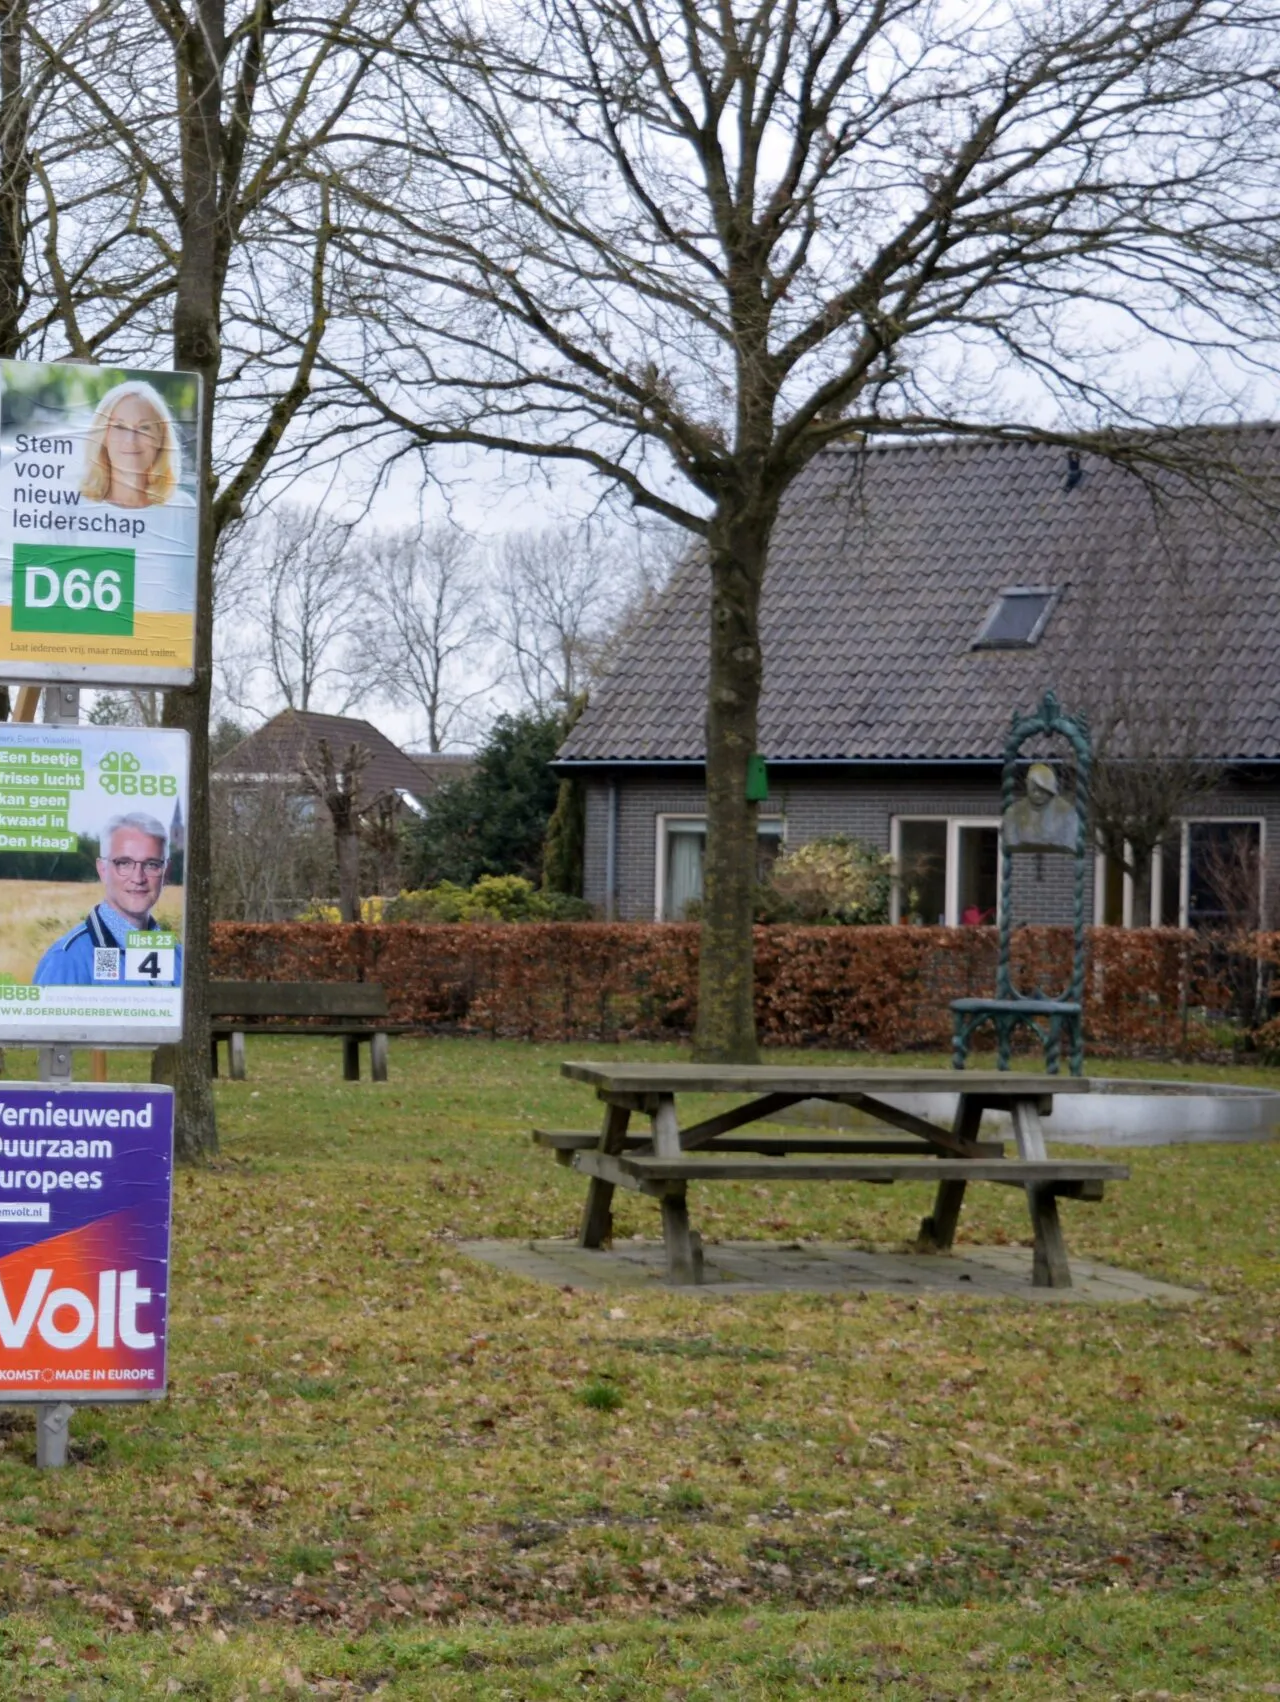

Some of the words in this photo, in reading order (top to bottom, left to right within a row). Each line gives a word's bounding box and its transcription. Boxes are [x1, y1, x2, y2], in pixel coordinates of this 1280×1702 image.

[15, 434, 73, 456] Stem
[14, 461, 65, 480] voor
[13, 486, 81, 506] nieuw
[12, 510, 146, 539] leiderschap
[24, 566, 122, 613] D66
[10, 642, 29, 652] Laat
[30, 643, 67, 654] iedereen
[87, 646, 110, 655] maar
[111, 646, 148, 657] niemand
[31, 751, 79, 767] beetje
[43, 772, 81, 786] lucht
[121, 774, 178, 797] BBB
[29, 796, 67, 808] geen
[51, 814, 65, 827] in
[128, 933, 153, 947] lijst
[156, 934, 172, 946] 23
[138, 951, 161, 979] 4
[4, 986, 40, 1001] BBB
[55, 1369, 90, 1381] MADE
[92, 1369, 106, 1381] IN
[107, 1369, 156, 1381] EUROPE
